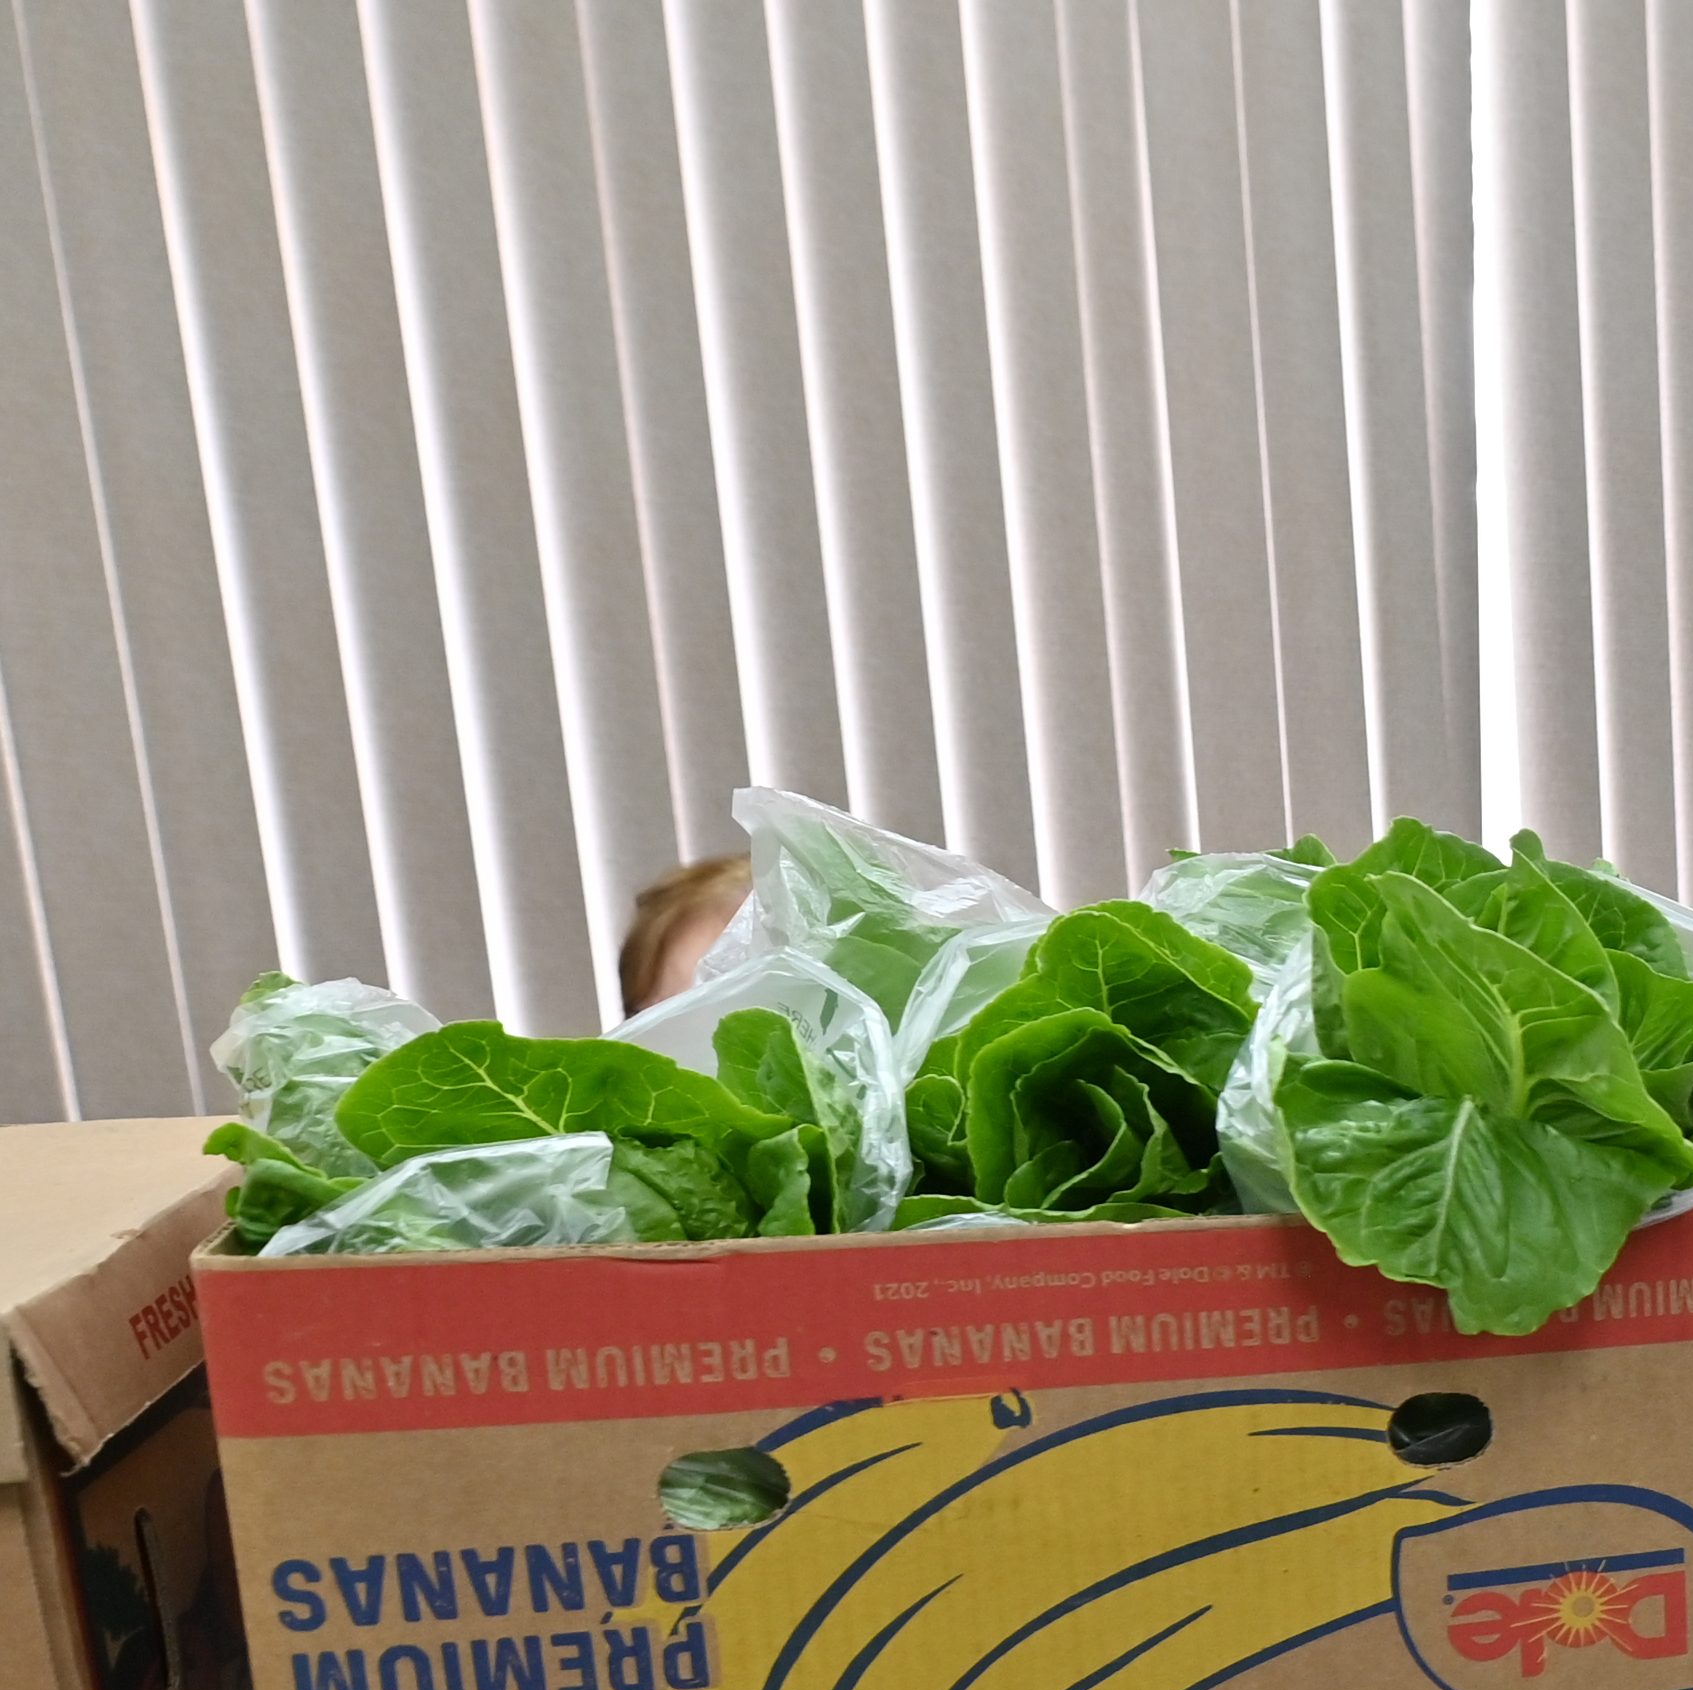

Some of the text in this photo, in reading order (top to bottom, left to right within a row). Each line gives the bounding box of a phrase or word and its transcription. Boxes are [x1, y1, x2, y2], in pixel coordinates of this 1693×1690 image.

[872, 1281, 930, 1301] 2021
[1101, 1269, 1153, 1287] Food
[1161, 1265, 1209, 1284] Dole
[128, 1274, 198, 1360] FRESH
[864, 1304, 1320, 1372] PREMIUM BANANAS
[263, 1337, 791, 1405] PREMIUM BANANAS
[271, 1533, 703, 1634] BANANAS
[1447, 1569, 1689, 1679] Dole
